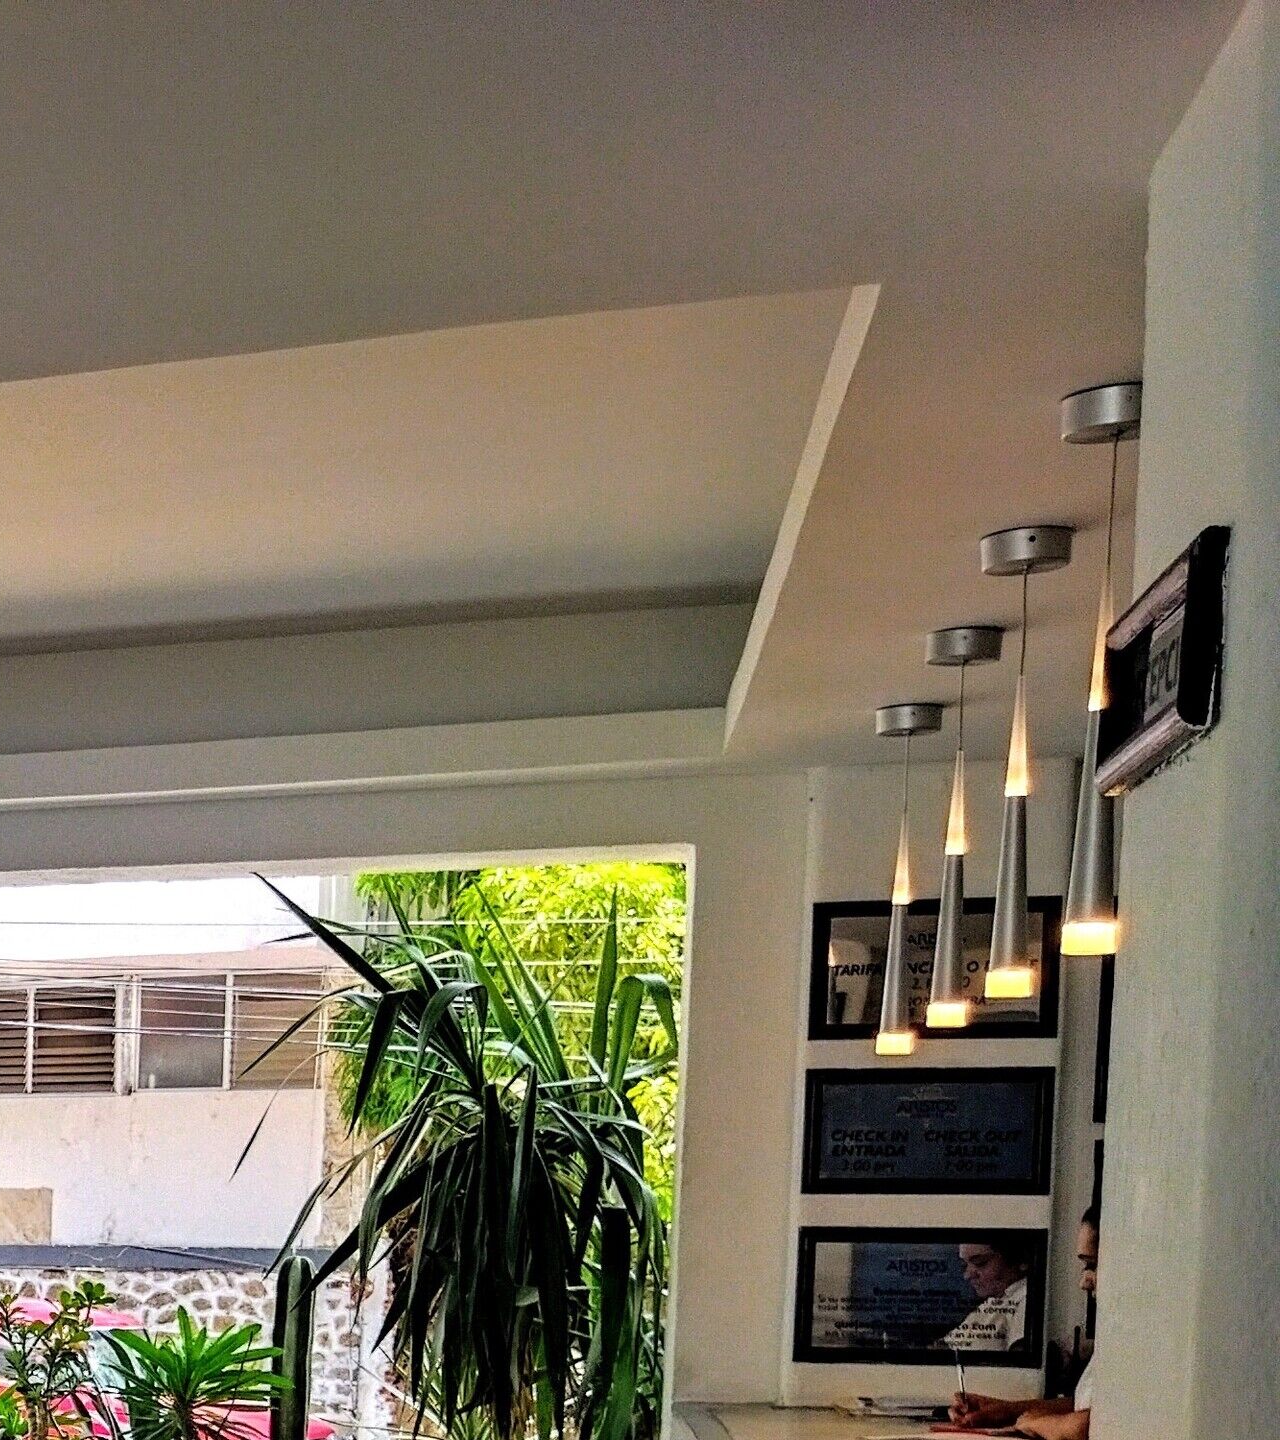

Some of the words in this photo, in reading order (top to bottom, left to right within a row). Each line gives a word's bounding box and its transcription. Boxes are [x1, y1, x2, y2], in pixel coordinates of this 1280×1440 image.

[831, 1129, 886, 1142] CHECK
[890, 1129, 910, 1142] IN
[924, 1129, 980, 1143] CHECK
[985, 1129, 1023, 1143] OUT
[831, 1145, 907, 1157] ENTRADA
[944, 1145, 1000, 1157] SALIDA
[886, 1258, 948, 1272] ARISTOS
